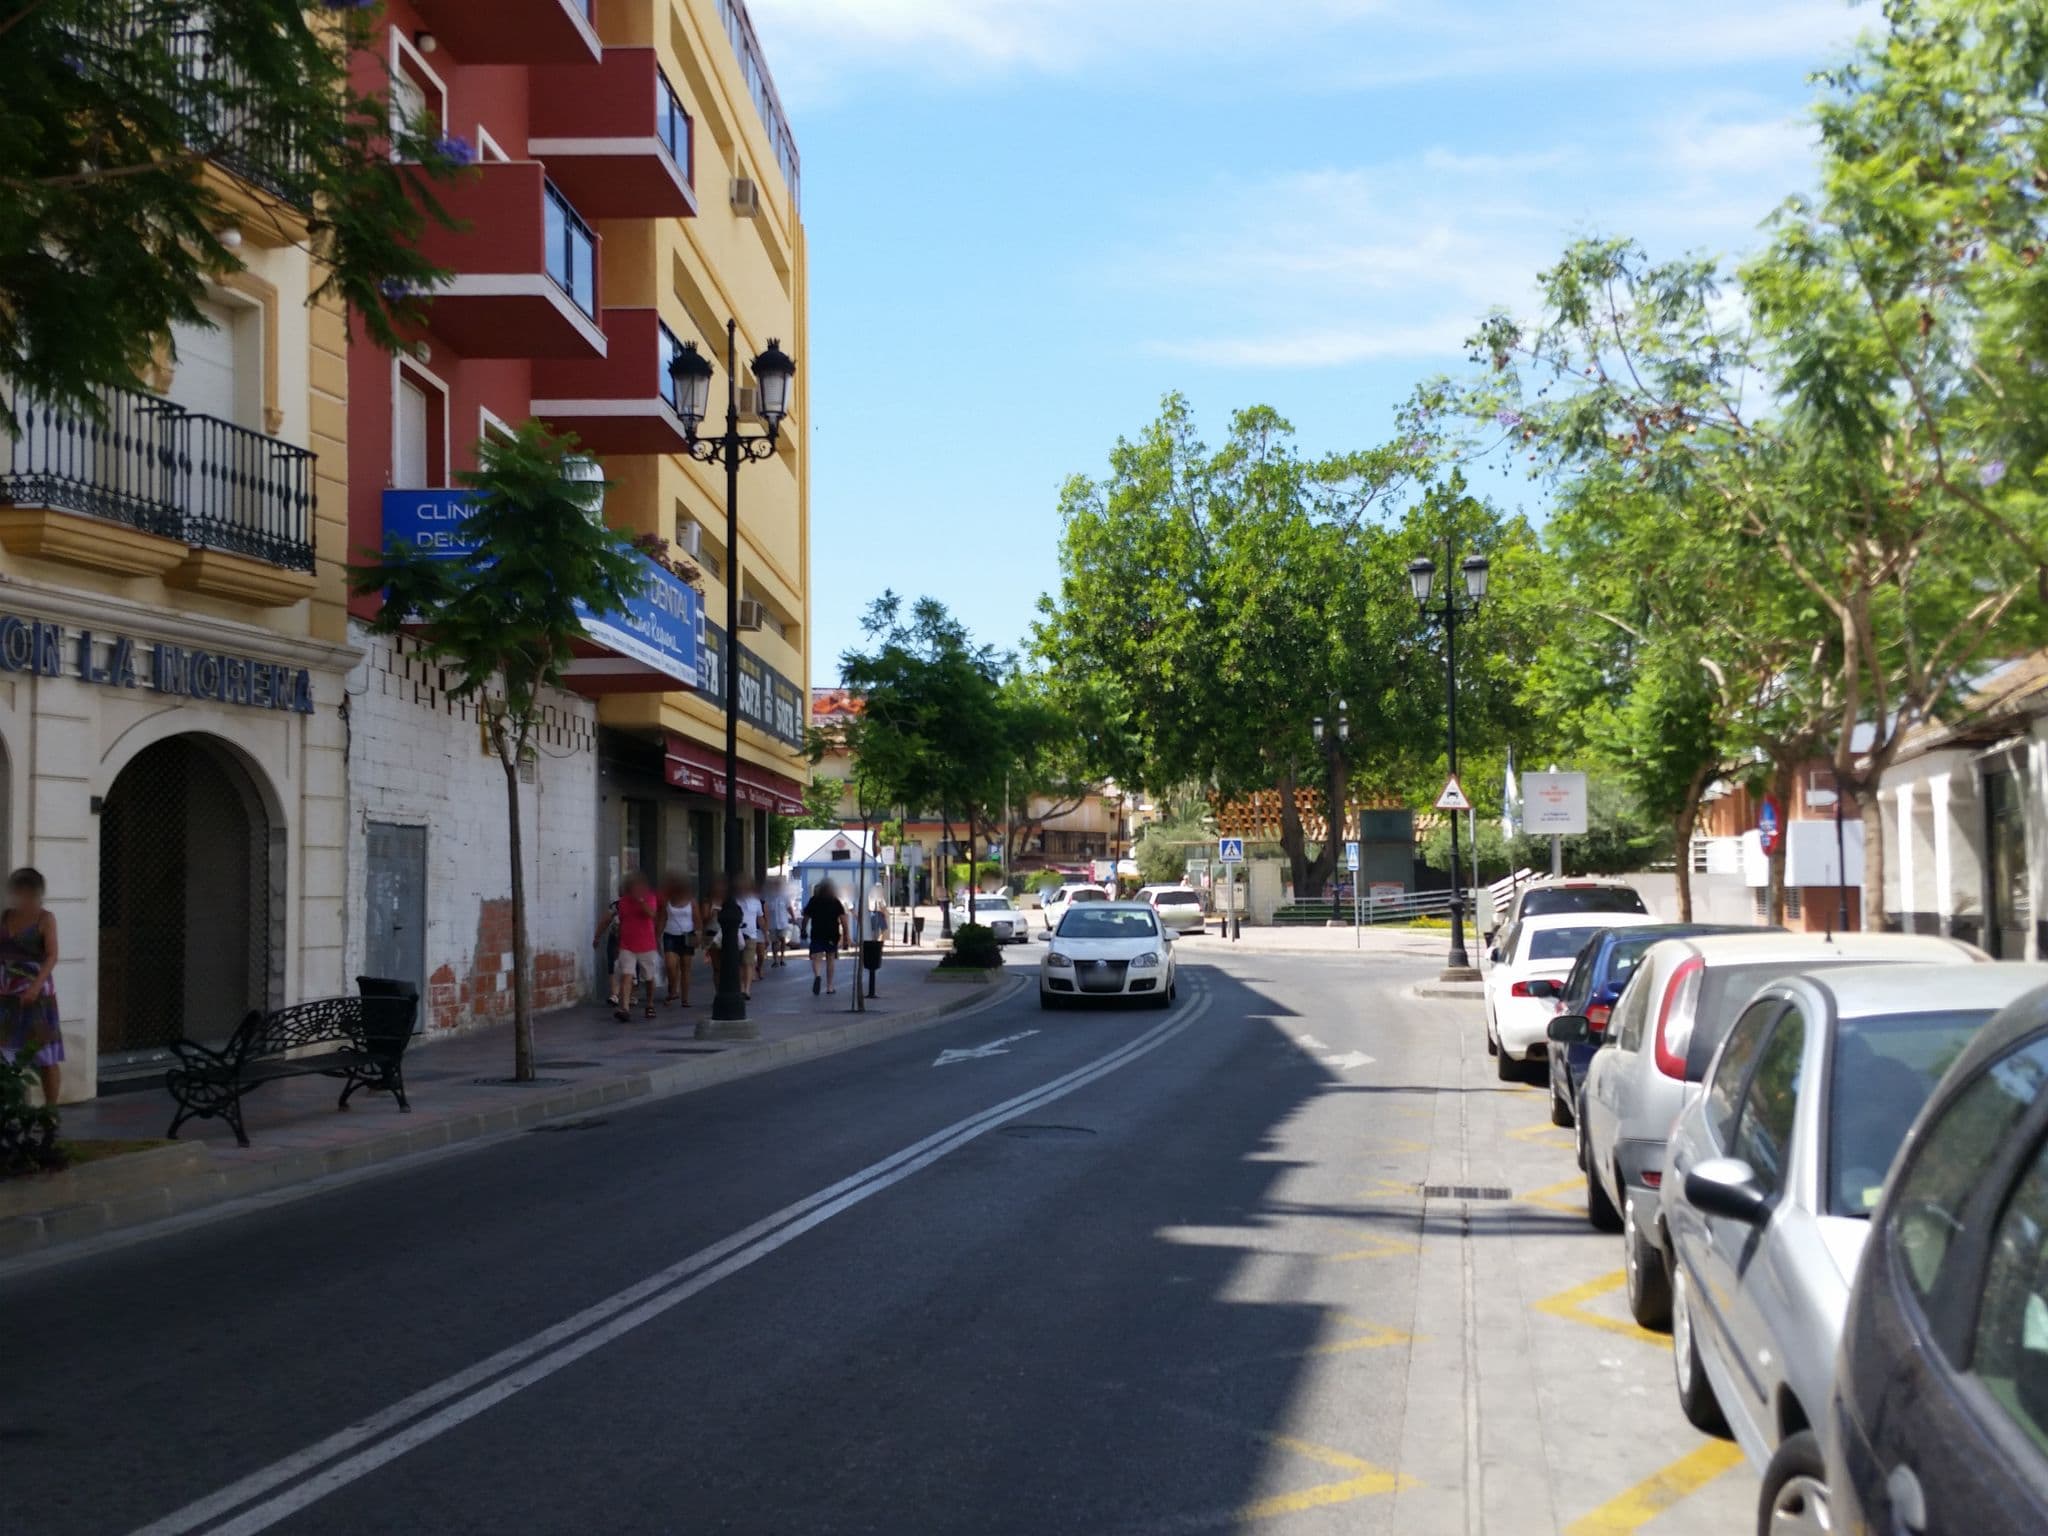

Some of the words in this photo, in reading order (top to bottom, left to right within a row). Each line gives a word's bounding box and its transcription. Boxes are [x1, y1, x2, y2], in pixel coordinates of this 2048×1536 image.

[650, 571, 692, 626] DENTAL
[79, 629, 138, 689] LA
[153, 642, 315, 714] MORENA
